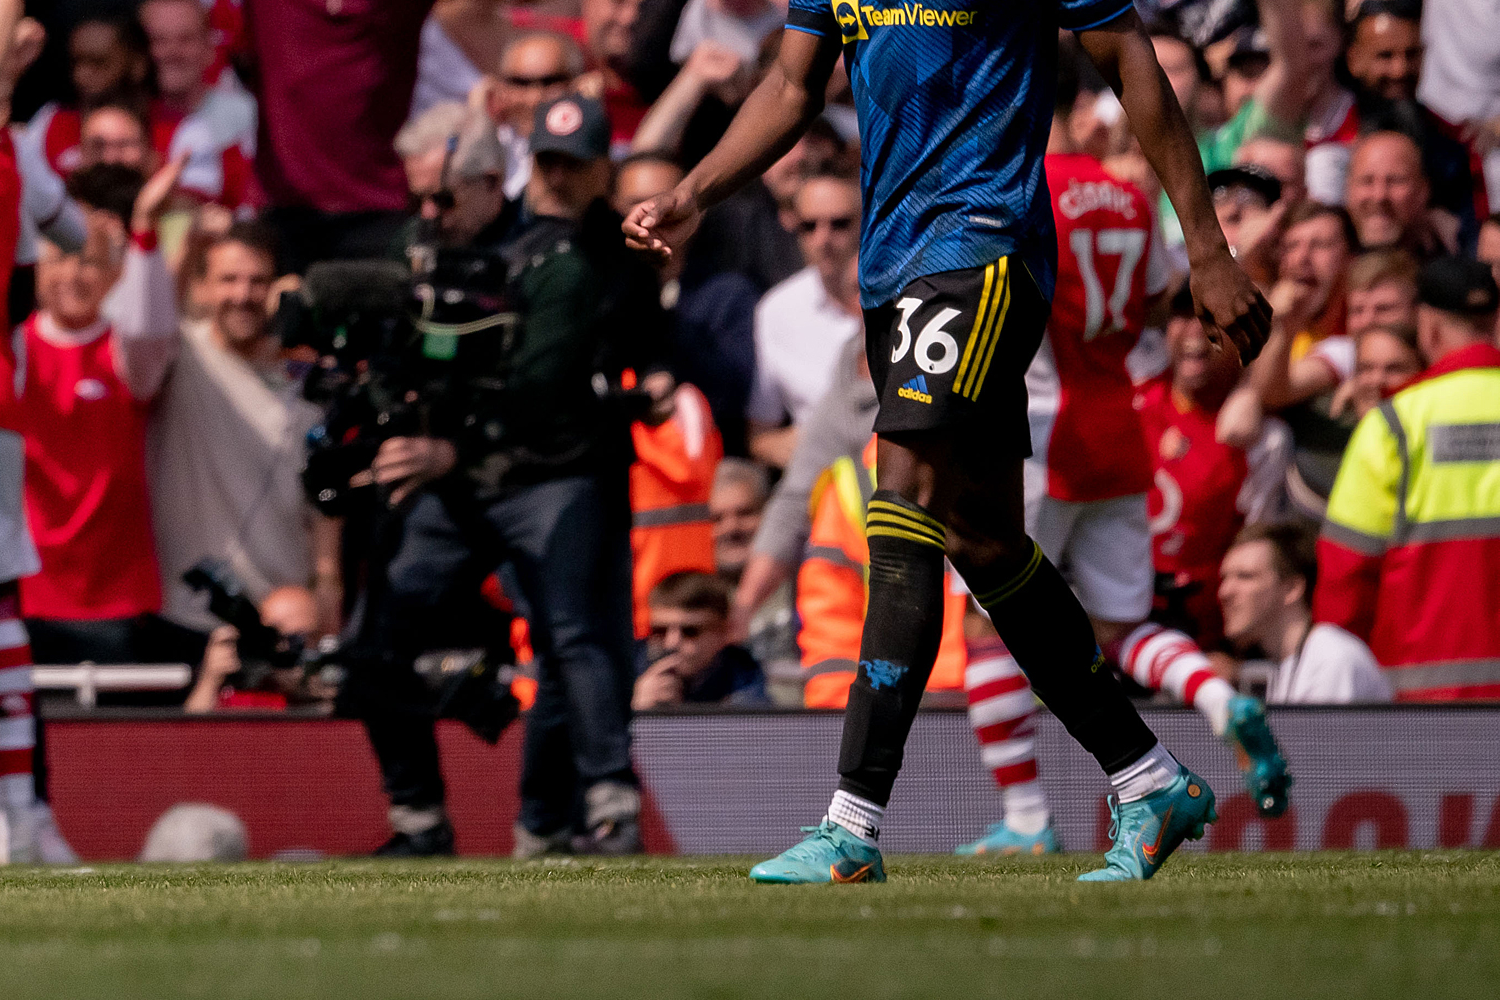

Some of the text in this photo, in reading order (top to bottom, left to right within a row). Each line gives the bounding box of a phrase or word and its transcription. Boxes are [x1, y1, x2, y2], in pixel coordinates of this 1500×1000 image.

[860, 2, 978, 27] TeamViewer
[1069, 227, 1148, 343] 17
[891, 297, 962, 375] 36
[898, 387, 932, 404] adidas
